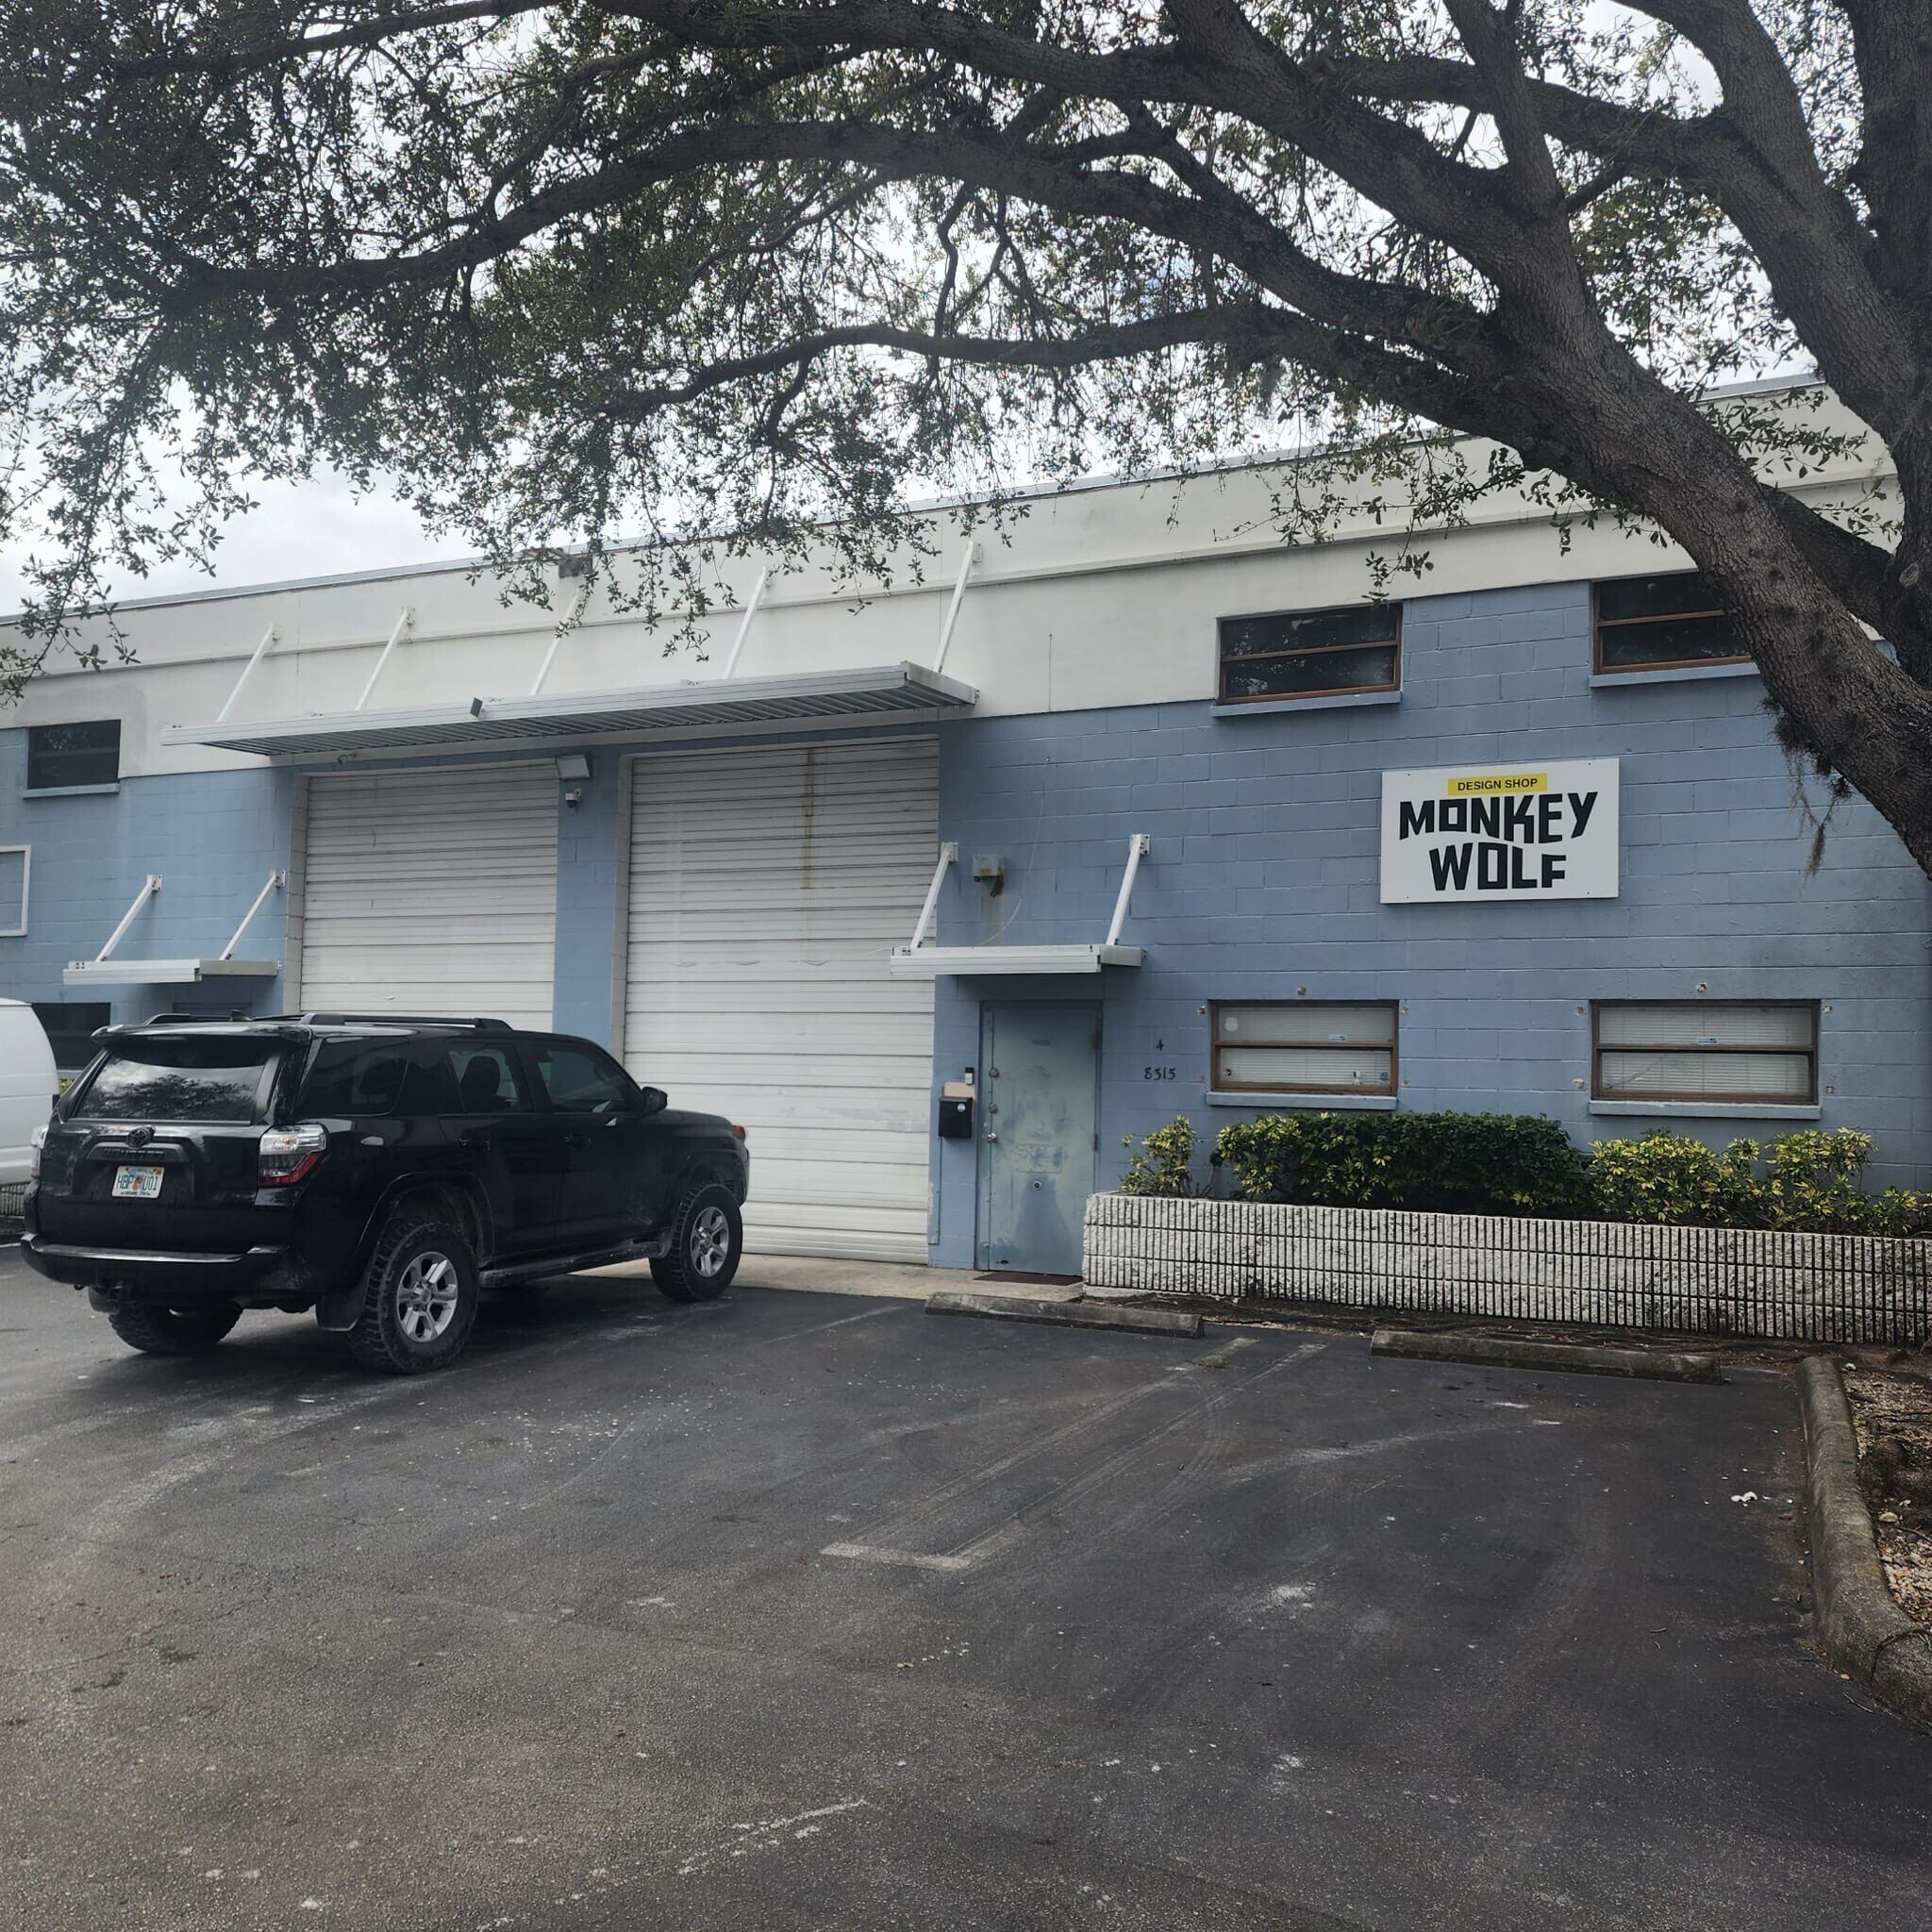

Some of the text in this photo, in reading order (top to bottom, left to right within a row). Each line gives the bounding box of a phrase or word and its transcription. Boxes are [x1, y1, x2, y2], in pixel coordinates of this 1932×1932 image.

[1457, 777, 1538, 791] DESIGN SHOP
[1399, 791, 1599, 844] MONKEY
[1428, 841, 1567, 891] WOLF
[1143, 1066, 1176, 1081] 8315
